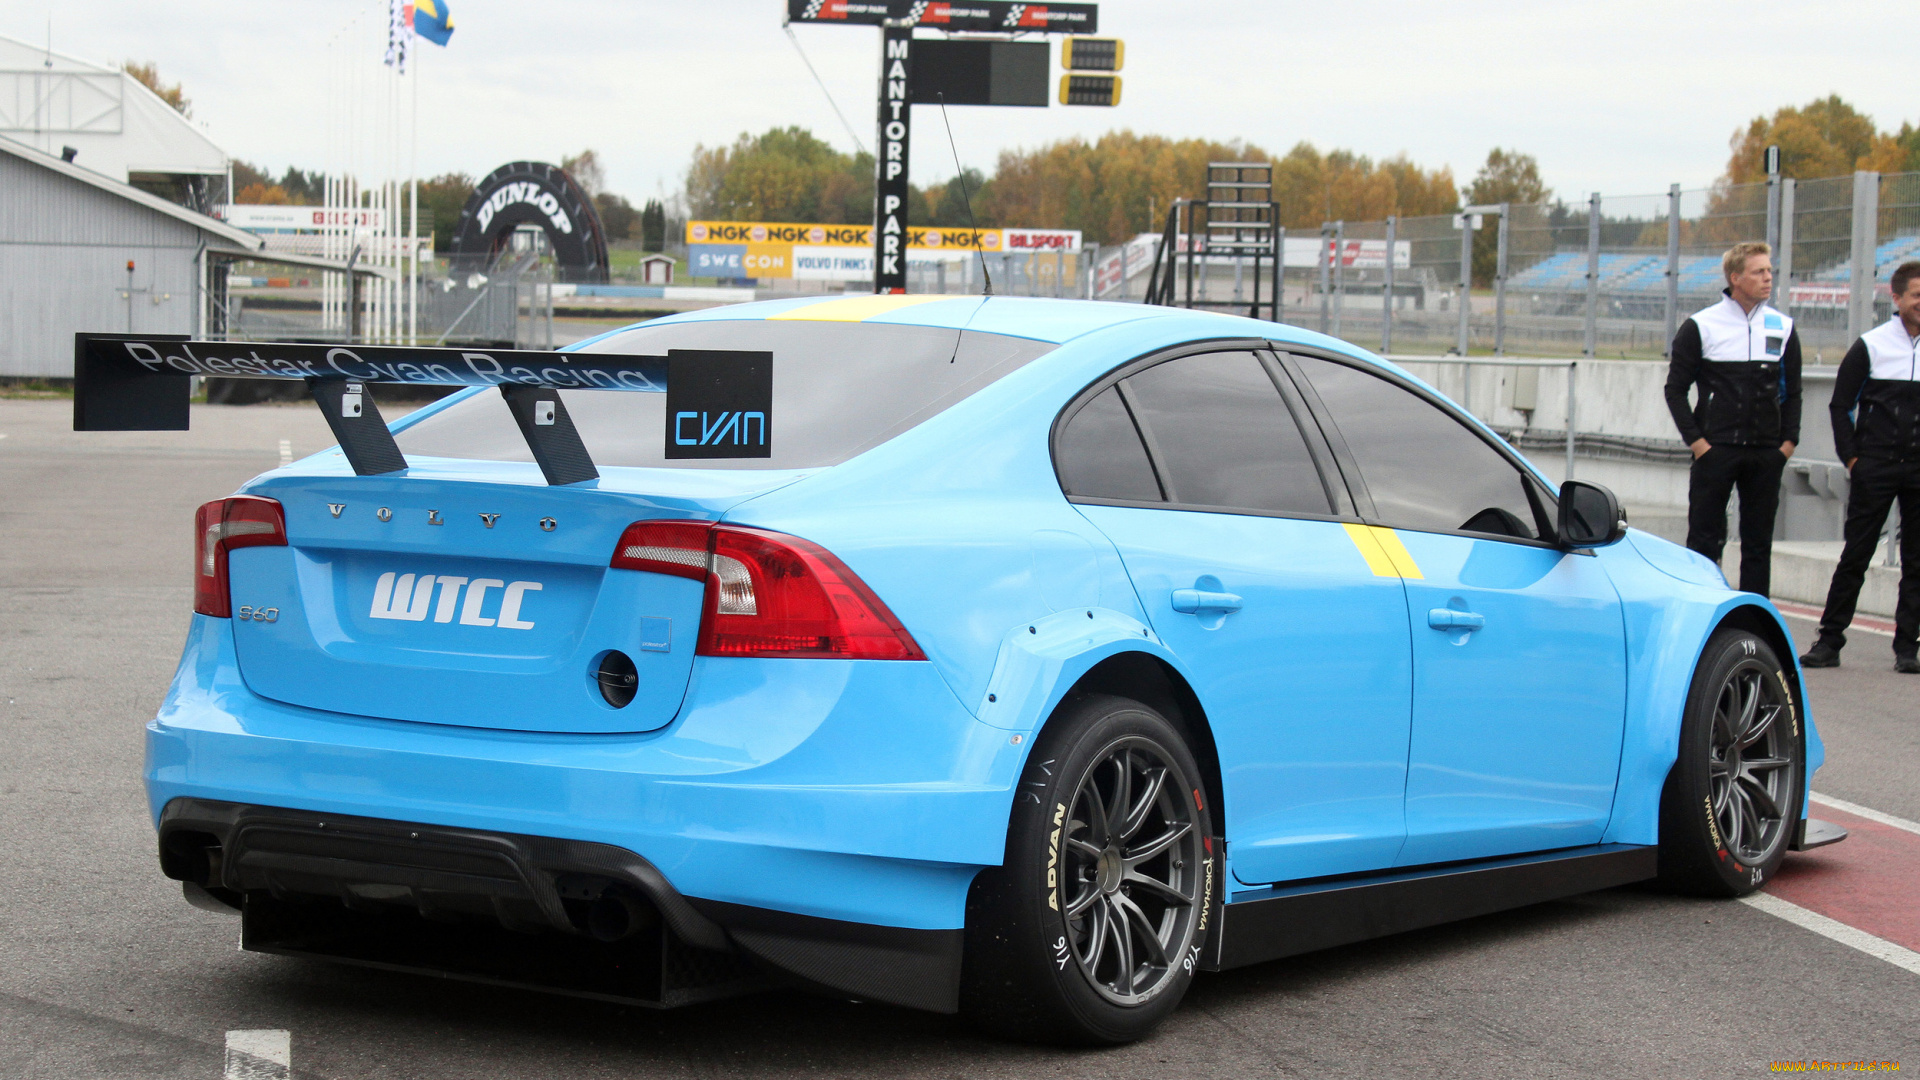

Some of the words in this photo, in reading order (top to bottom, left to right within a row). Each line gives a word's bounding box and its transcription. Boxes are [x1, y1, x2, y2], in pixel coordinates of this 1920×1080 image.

[831, 3, 867, 13] MANTORP
[868, 5, 888, 14] PARK
[934, 8, 969, 17] MANTORP
[970, 9, 991, 18] PARK
[1031, 12, 1067, 21] MANTORP
[1068, 13, 1087, 22] PARK
[885, 38, 908, 181] MANTORP
[476, 181, 573, 234] DUNLOP
[709, 226, 750, 241] NGK
[768, 227, 811, 242] NGK
[826, 229, 868, 244] NGK
[883, 195, 901, 275] PARK
[942, 232, 984, 247] NGK
[1009, 234, 1074, 249] BILSPORT
[797, 256, 831, 269] VOLVO
[834, 257, 867, 270] FINNS
[124, 342, 322, 378] Polestar
[326, 347, 466, 383] Cyan
[461, 352, 668, 392] Racing
[675, 411, 765, 446] CYAN
[327, 502, 558, 532] VOLVO
[239, 605, 280, 623] S60
[369, 572, 543, 630] WTCC
[1776, 669, 1799, 738] ADVAN
[1704, 794, 1722, 851] YOKOHAMA
[1047, 802, 1067, 912] ADVAN
[1198, 857, 1215, 931] YOKOHAMA
[1053, 935, 1071, 971] Y16
[1183, 944, 1201, 977] Y16
